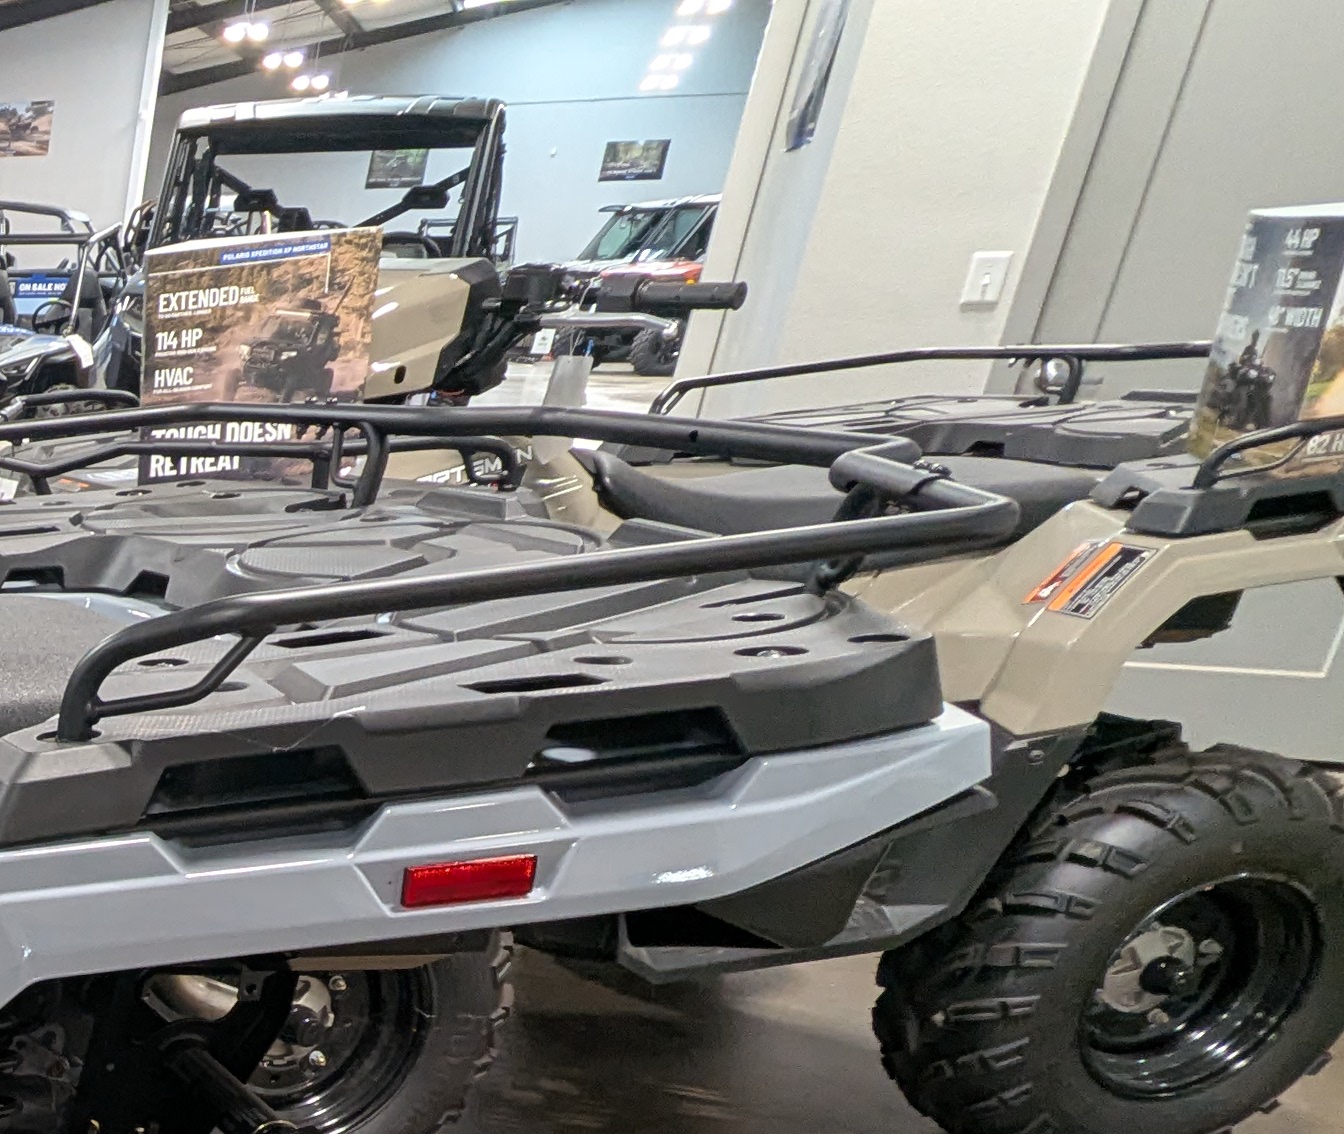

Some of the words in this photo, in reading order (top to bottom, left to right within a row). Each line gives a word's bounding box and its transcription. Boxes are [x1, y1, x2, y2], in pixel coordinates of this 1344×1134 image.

[222, 251, 251, 262] POLARIS
[18, 282, 32, 292] ON
[32, 282, 53, 292] SALE
[158, 285, 241, 314] EXTENDED
[156, 330, 179, 352] 114
[181, 328, 203, 349] HP
[154, 367, 194, 388] HVAC
